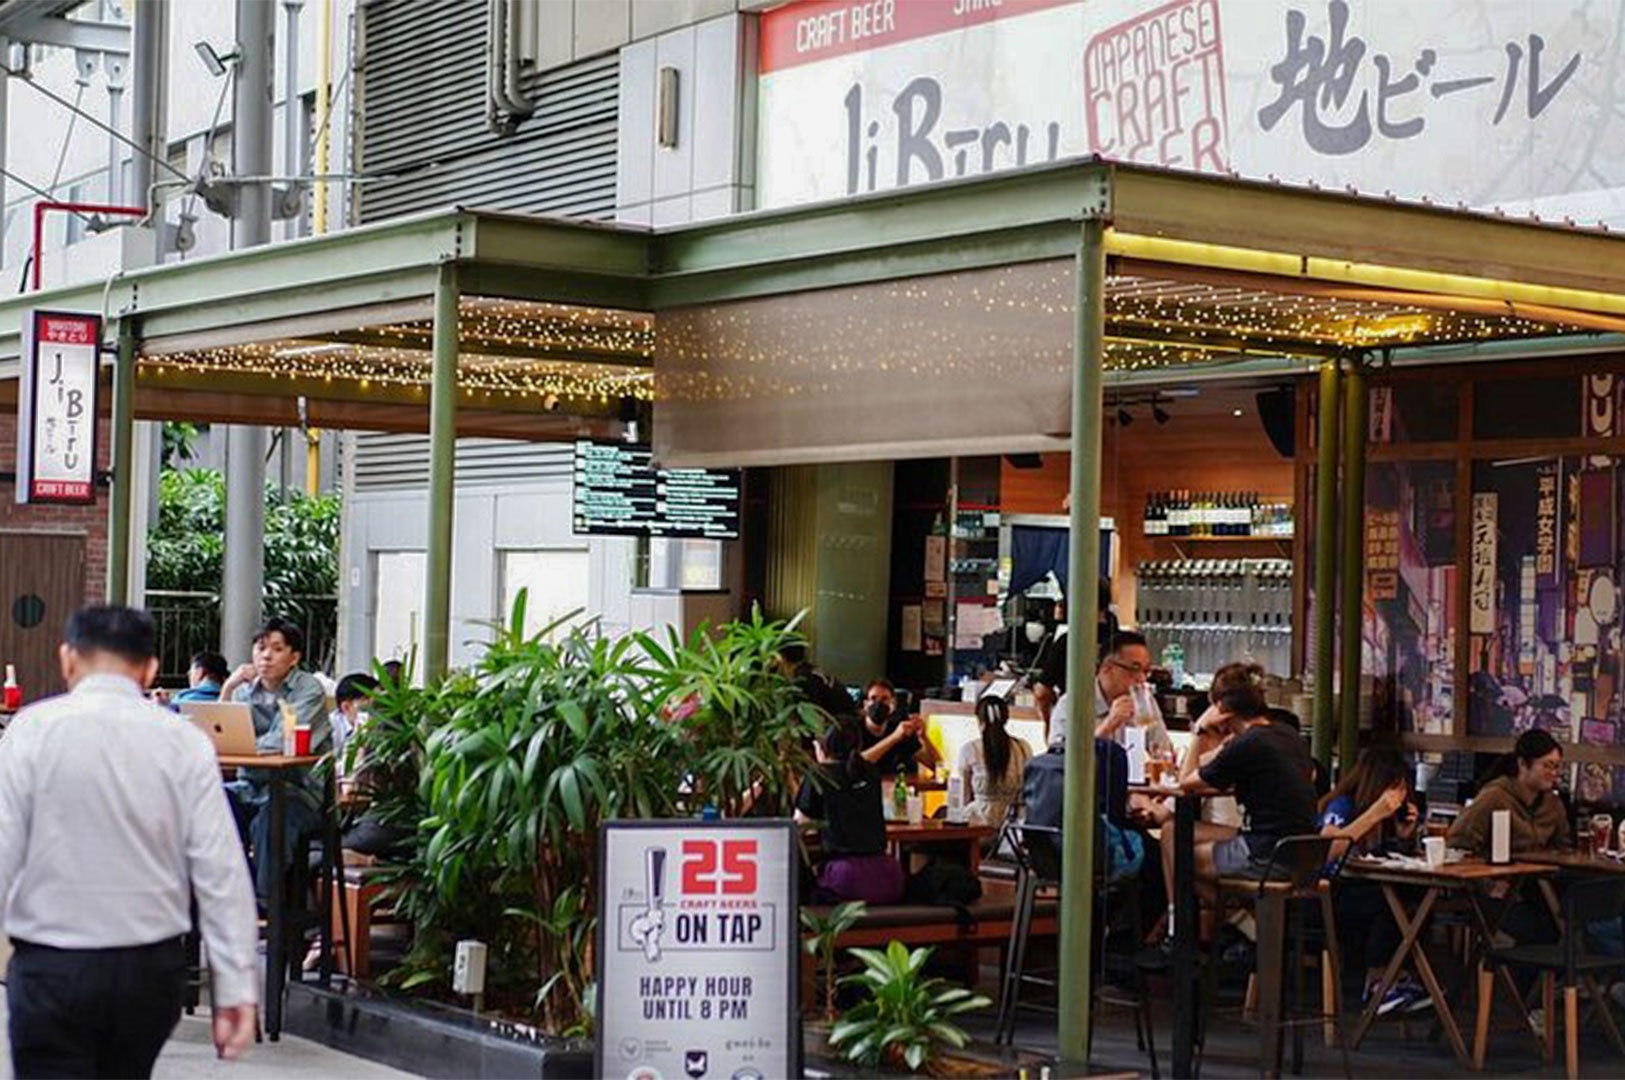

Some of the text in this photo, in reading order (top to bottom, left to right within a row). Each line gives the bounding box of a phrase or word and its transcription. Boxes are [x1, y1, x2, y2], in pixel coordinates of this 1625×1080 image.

[797, 2, 895, 52] CRAFT BEER
[1089, 1, 1218, 93] JAPANESE
[1258, 0, 1580, 155] 地ビール
[1093, 46, 1221, 153] CRAFT
[36, 483, 88, 496] CRAFT BEER
[682, 840, 757, 894] 25
[680, 900, 757, 909] CRAFT BEERS
[676, 914, 762, 942] ON TAP
[639, 976, 752, 998] HAPPY HOUR
[643, 1000, 748, 1020] UNTIL 8 PM
